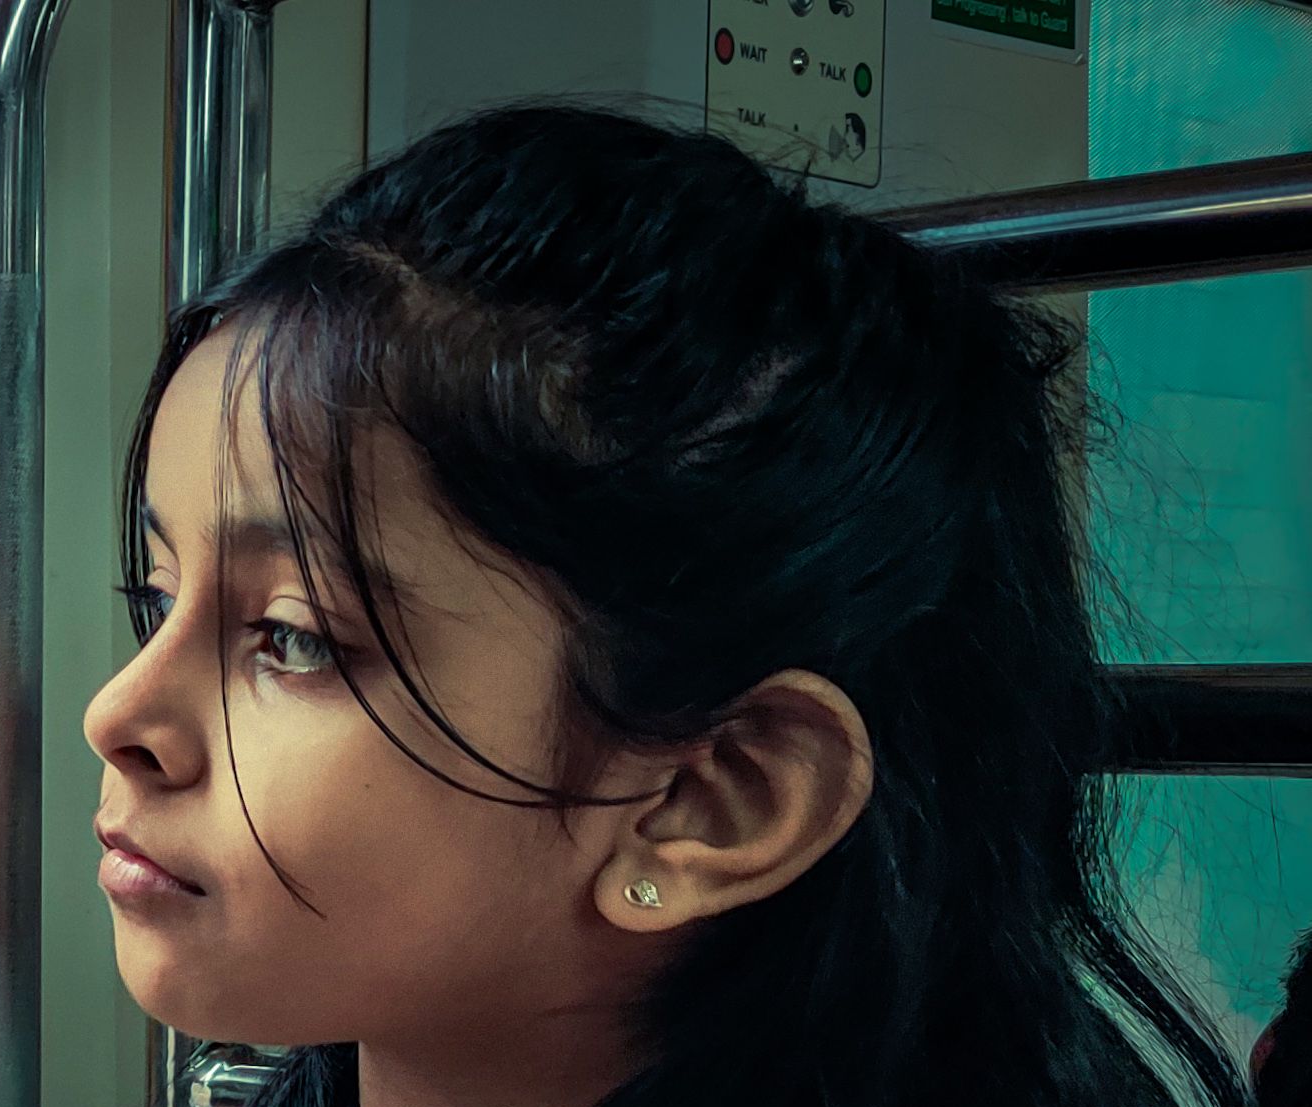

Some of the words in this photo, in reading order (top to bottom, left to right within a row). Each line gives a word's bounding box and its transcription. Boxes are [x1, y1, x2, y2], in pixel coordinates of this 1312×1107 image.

[740, 43, 768, 64] WAIT
[820, 62, 847, 82] TALK
[738, 108, 766, 127] TALK
